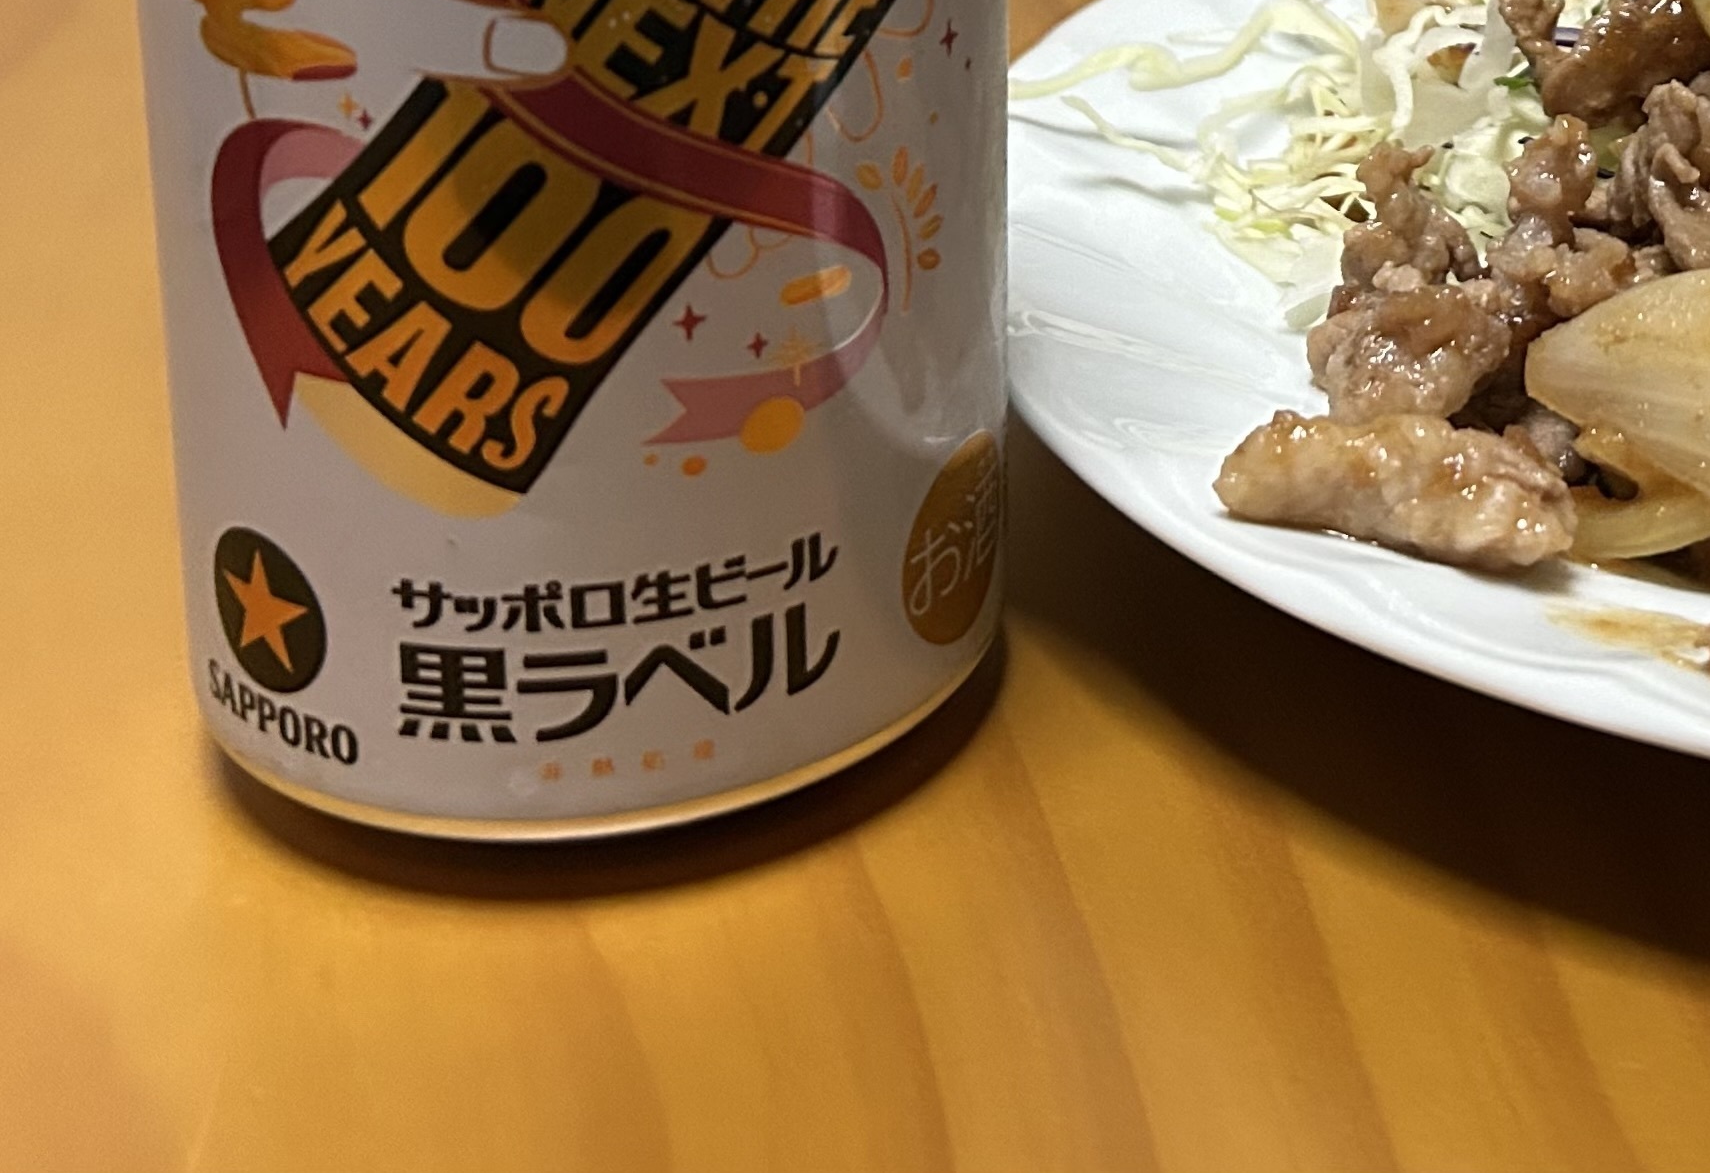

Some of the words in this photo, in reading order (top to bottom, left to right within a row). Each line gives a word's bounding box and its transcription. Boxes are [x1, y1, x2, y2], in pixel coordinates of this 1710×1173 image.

[356, 83, 716, 365] 100
[283, 198, 571, 471] YEARS
[392, 532, 838, 634] サッポロ生ビール
[208, 658, 360, 767] SAPPORO
[399, 602, 842, 744] 黒ラベル
